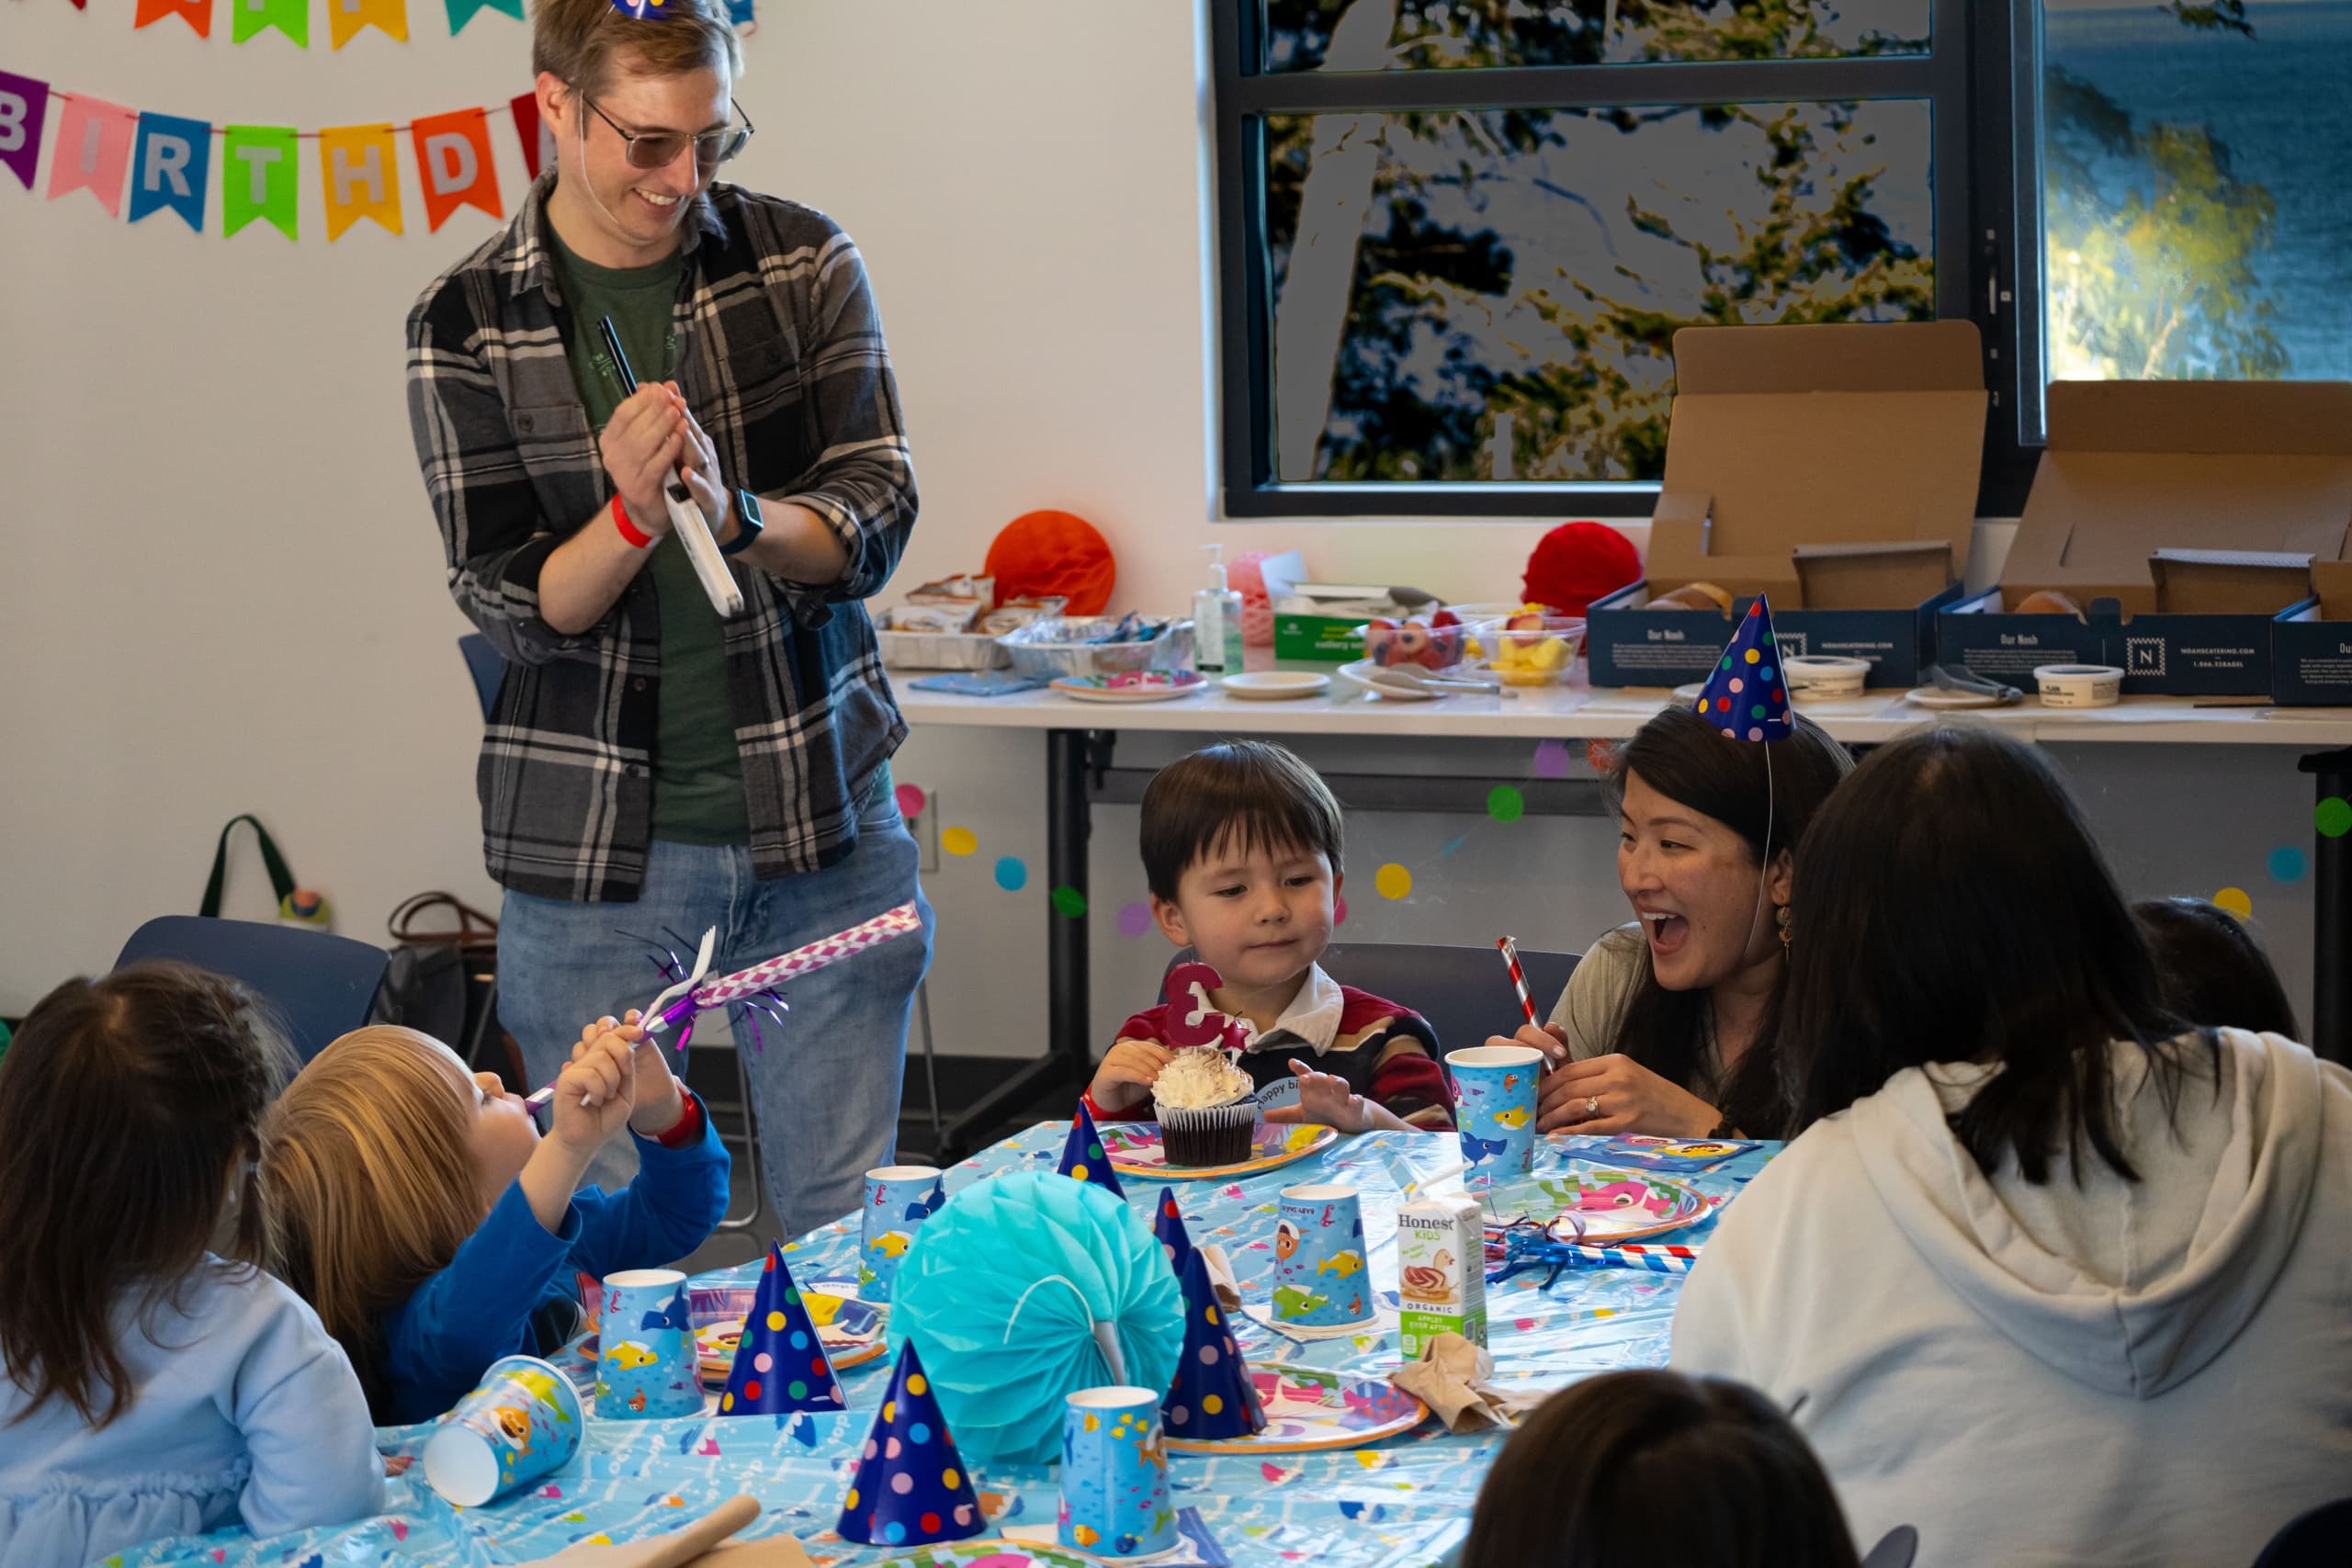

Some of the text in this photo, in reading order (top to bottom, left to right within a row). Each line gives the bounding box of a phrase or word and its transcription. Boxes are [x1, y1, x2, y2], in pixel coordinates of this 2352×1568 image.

[0, 91, 558, 205] BIRTHD
[2000, 633, 2015, 645] Our
[2339, 642, 2352, 653] Ou
[2139, 649, 2154, 664] N
[1288, 1079, 1301, 1089] bi
[1397, 1213, 1454, 1231] Honest
[1414, 1229, 1441, 1241] KIDS
[1407, 1303, 1453, 1314] ORGANIC
